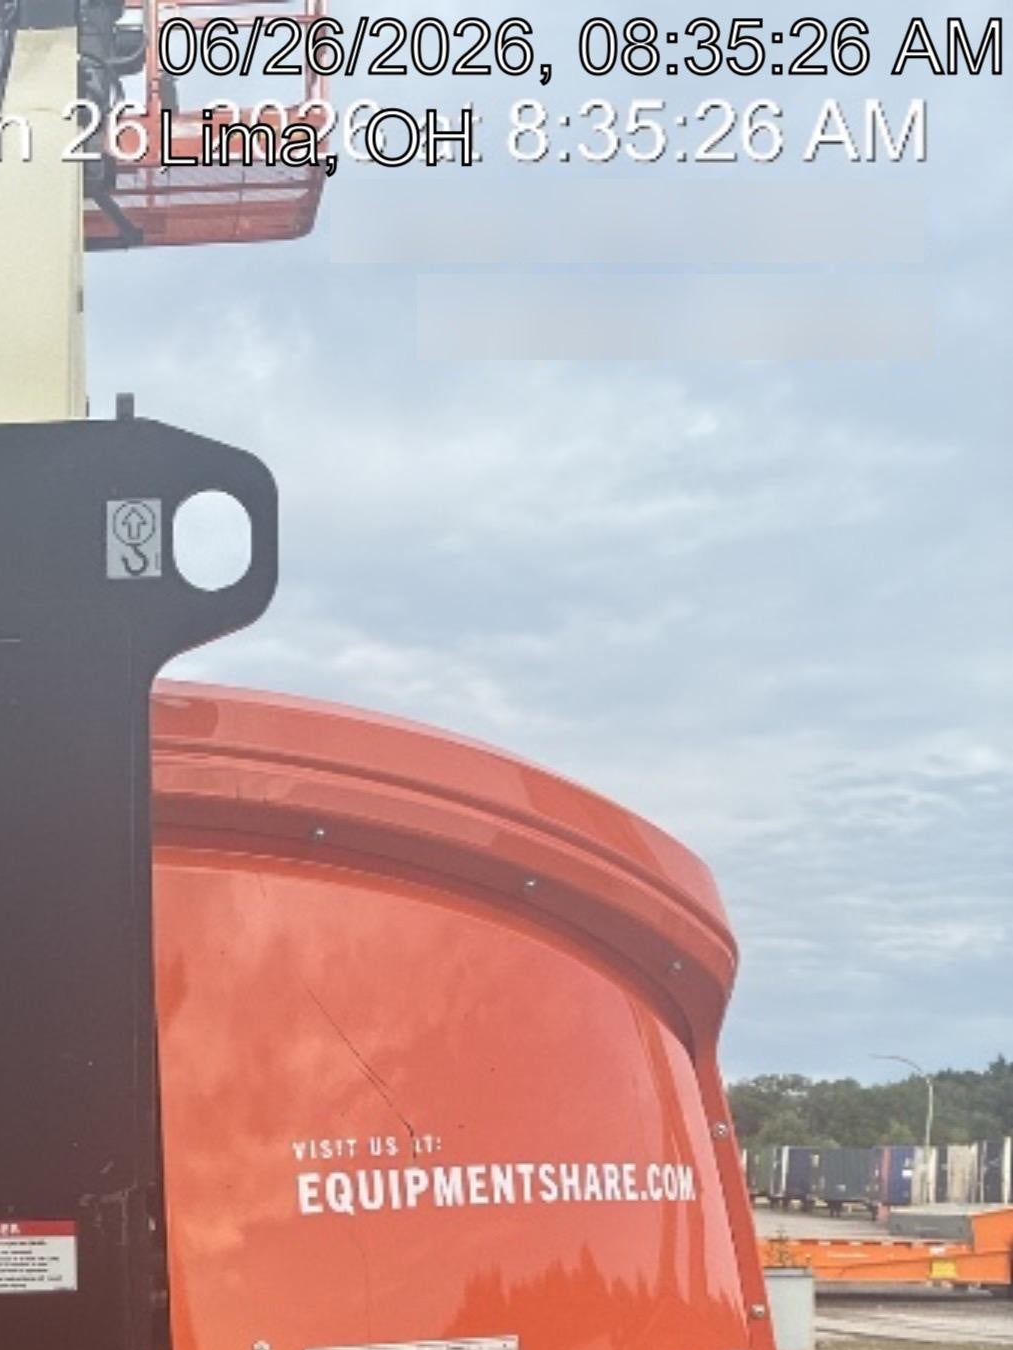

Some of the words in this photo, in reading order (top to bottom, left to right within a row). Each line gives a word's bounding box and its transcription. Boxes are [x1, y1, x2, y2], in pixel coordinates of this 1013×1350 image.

[292, 1138, 358, 1161] VISIT
[370, 1136, 399, 1156] US
[297, 1162, 696, 1216] EQUIPMENTSHARE.COM
